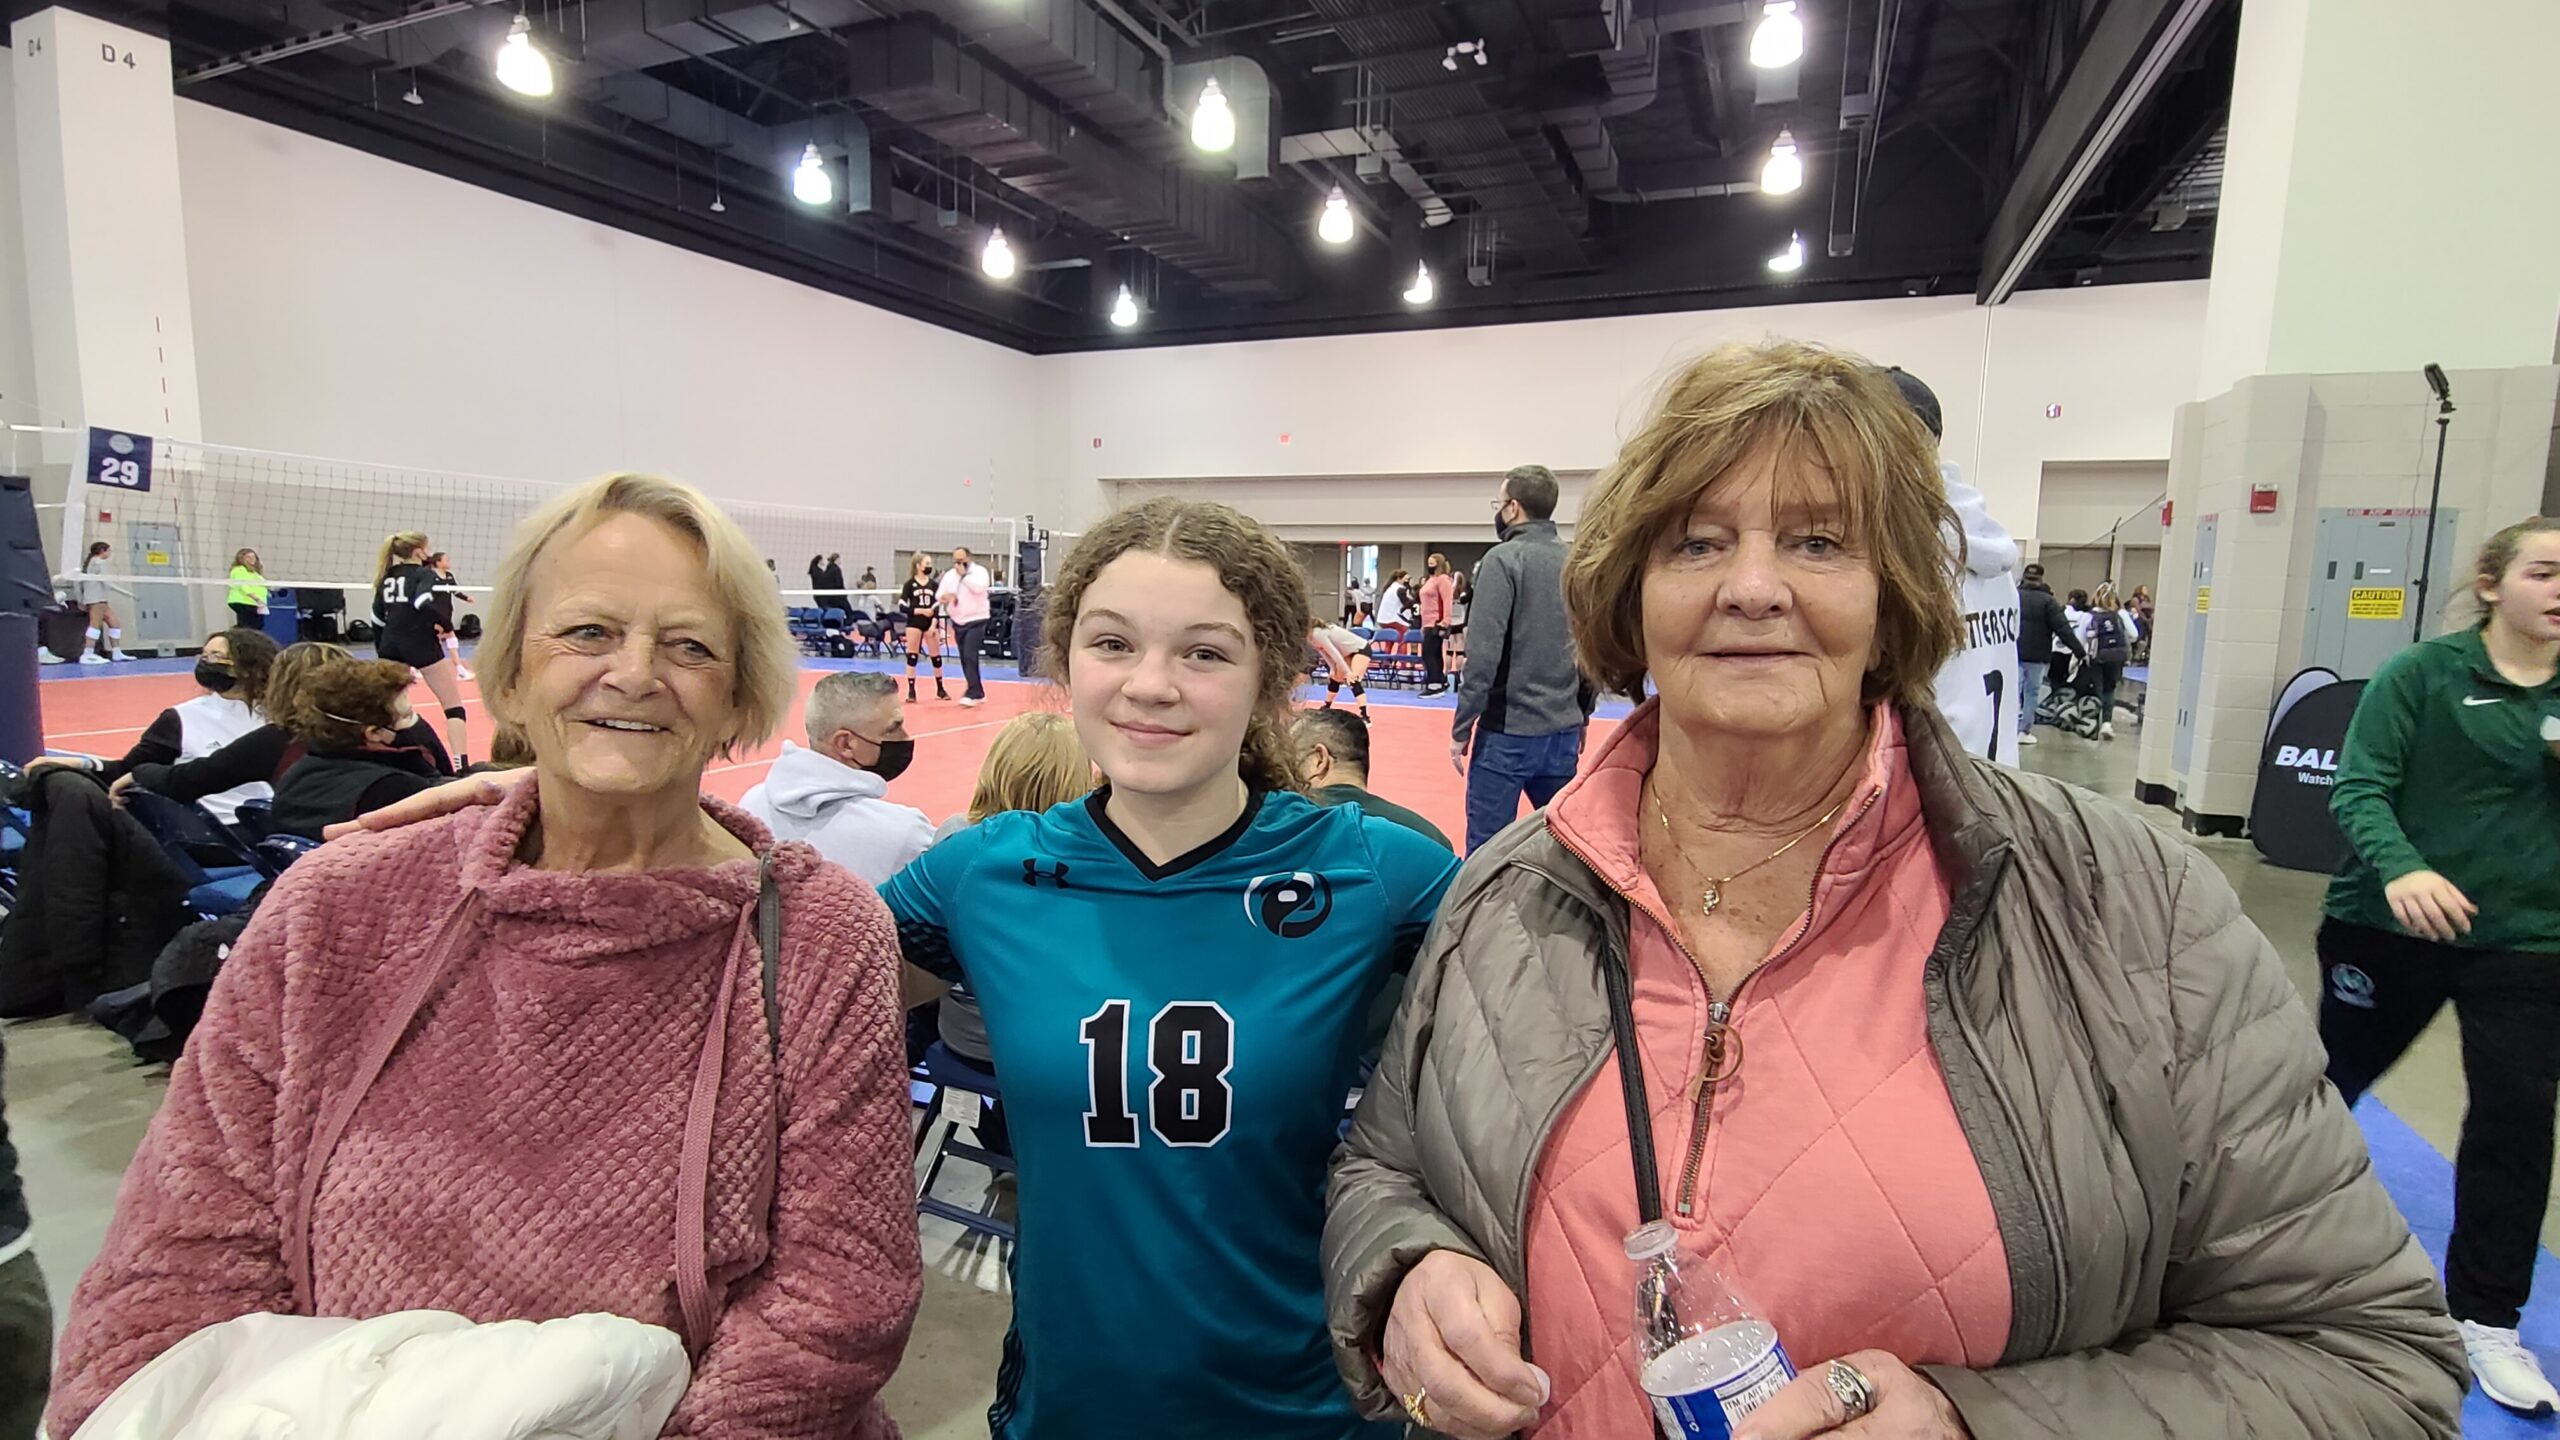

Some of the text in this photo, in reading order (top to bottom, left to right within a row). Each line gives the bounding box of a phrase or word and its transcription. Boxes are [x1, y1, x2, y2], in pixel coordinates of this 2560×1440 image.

[100, 457, 139, 486] 29
[383, 576, 409, 603] 21
[2353, 591, 2400, 600] CAUTION
[2275, 745, 2338, 771] BAL
[2298, 771, 2334, 786] Watch
[1079, 999, 1235, 1148] 18
